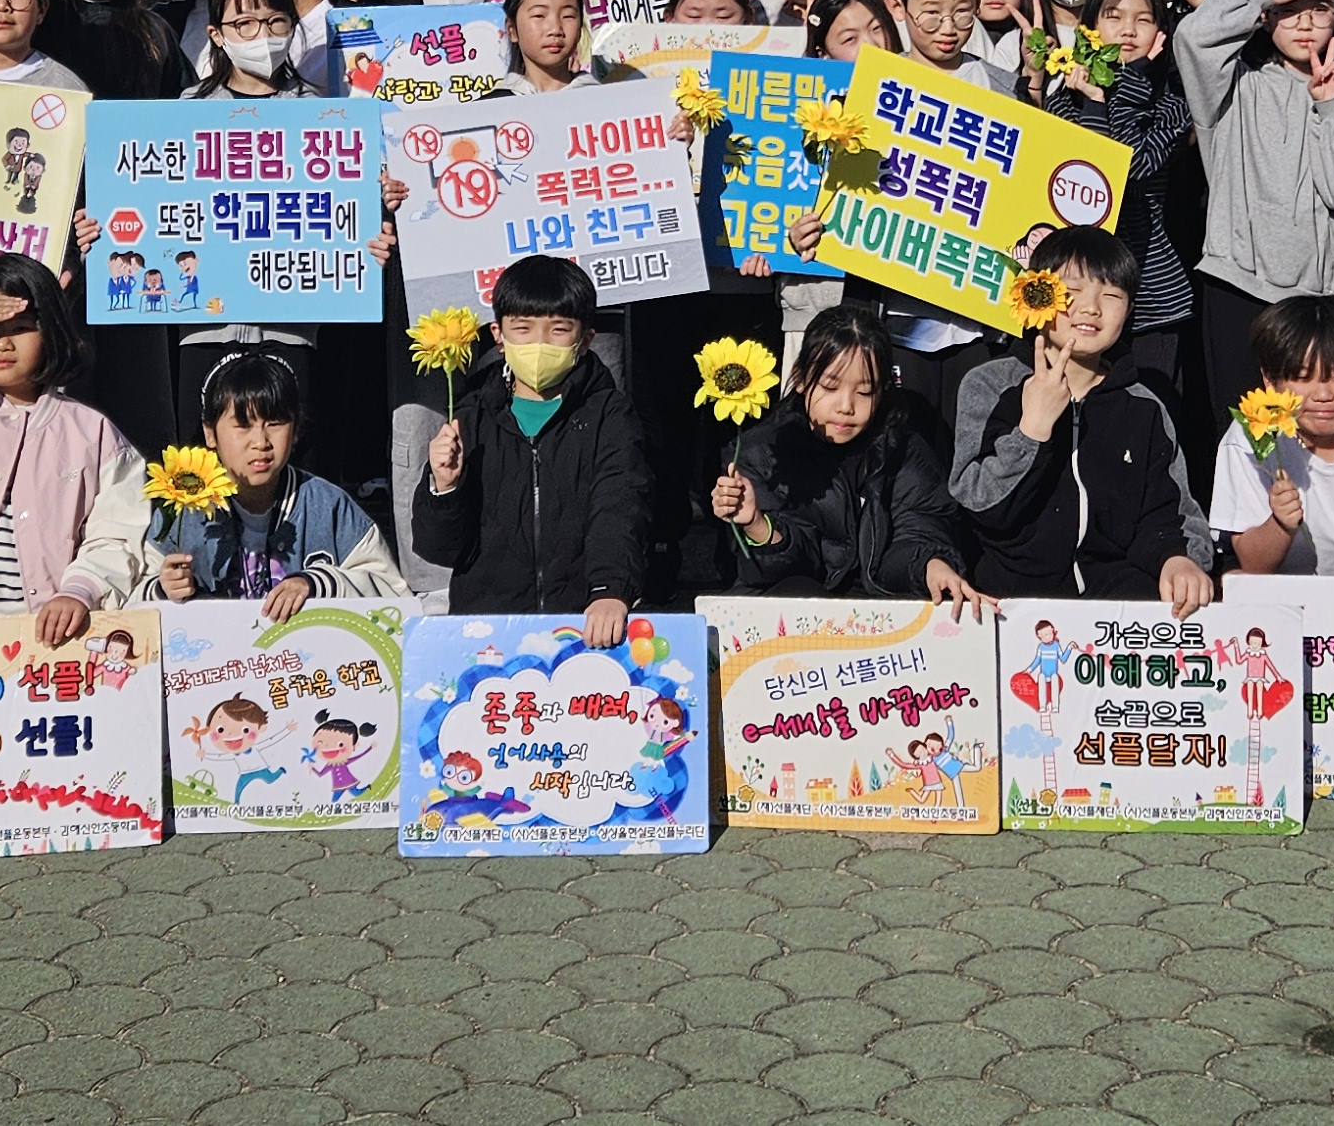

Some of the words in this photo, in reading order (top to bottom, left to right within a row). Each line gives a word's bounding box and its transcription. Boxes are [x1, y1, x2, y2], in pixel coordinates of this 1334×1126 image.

[410, 24, 477, 66] 선플,
[372, 77, 442, 104] 사랑과
[566, 114, 667, 162] 사이버
[873, 79, 1023, 177] 학교폭력
[115, 139, 187, 184] 사소한
[193, 129, 294, 182] 괴롭힘,
[301, 128, 365, 182] 장난
[535, 162, 675, 209] 폭력은...
[878, 146, 989, 228] 성폭력
[1053, 176, 1108, 210] STOP
[111, 219, 142, 233] STOP
[156, 201, 205, 242] 또한
[211, 191, 360, 244] 학교폭력에
[505, 213, 575, 258] 나와
[586, 203, 682, 250] 친구를
[247, 248, 366, 292] 해당됩니다
[824, 193, 1010, 305] 사이버폭력
[591, 252, 671, 289] 합니다
[1094, 622, 1206, 650] 가슴으로
[17, 660, 96, 703] 선플!
[336, 660, 382, 689] 학교
[765, 666, 829, 701] 당신의
[835, 648, 927, 687] 선플하나!
[1074, 653, 1227, 692] 이해하고,
[481, 691, 563, 735] 존중과
[568, 691, 638, 724] 배려,
[859, 682, 979, 727] 바꿉니다.
[1095, 700, 1207, 728] 손끝으로
[16, 715, 94, 757] 선플!
[1074, 731, 1228, 768] 선플달자!
[529, 770, 636, 798] 시작입니다.
[756, 801, 812, 815] (재)선플재단
[901, 808, 978, 820] 김해신안초등학교
[1058, 805, 1115, 819] (재)선플재단
[444, 828, 502, 841] (재)선플재단
